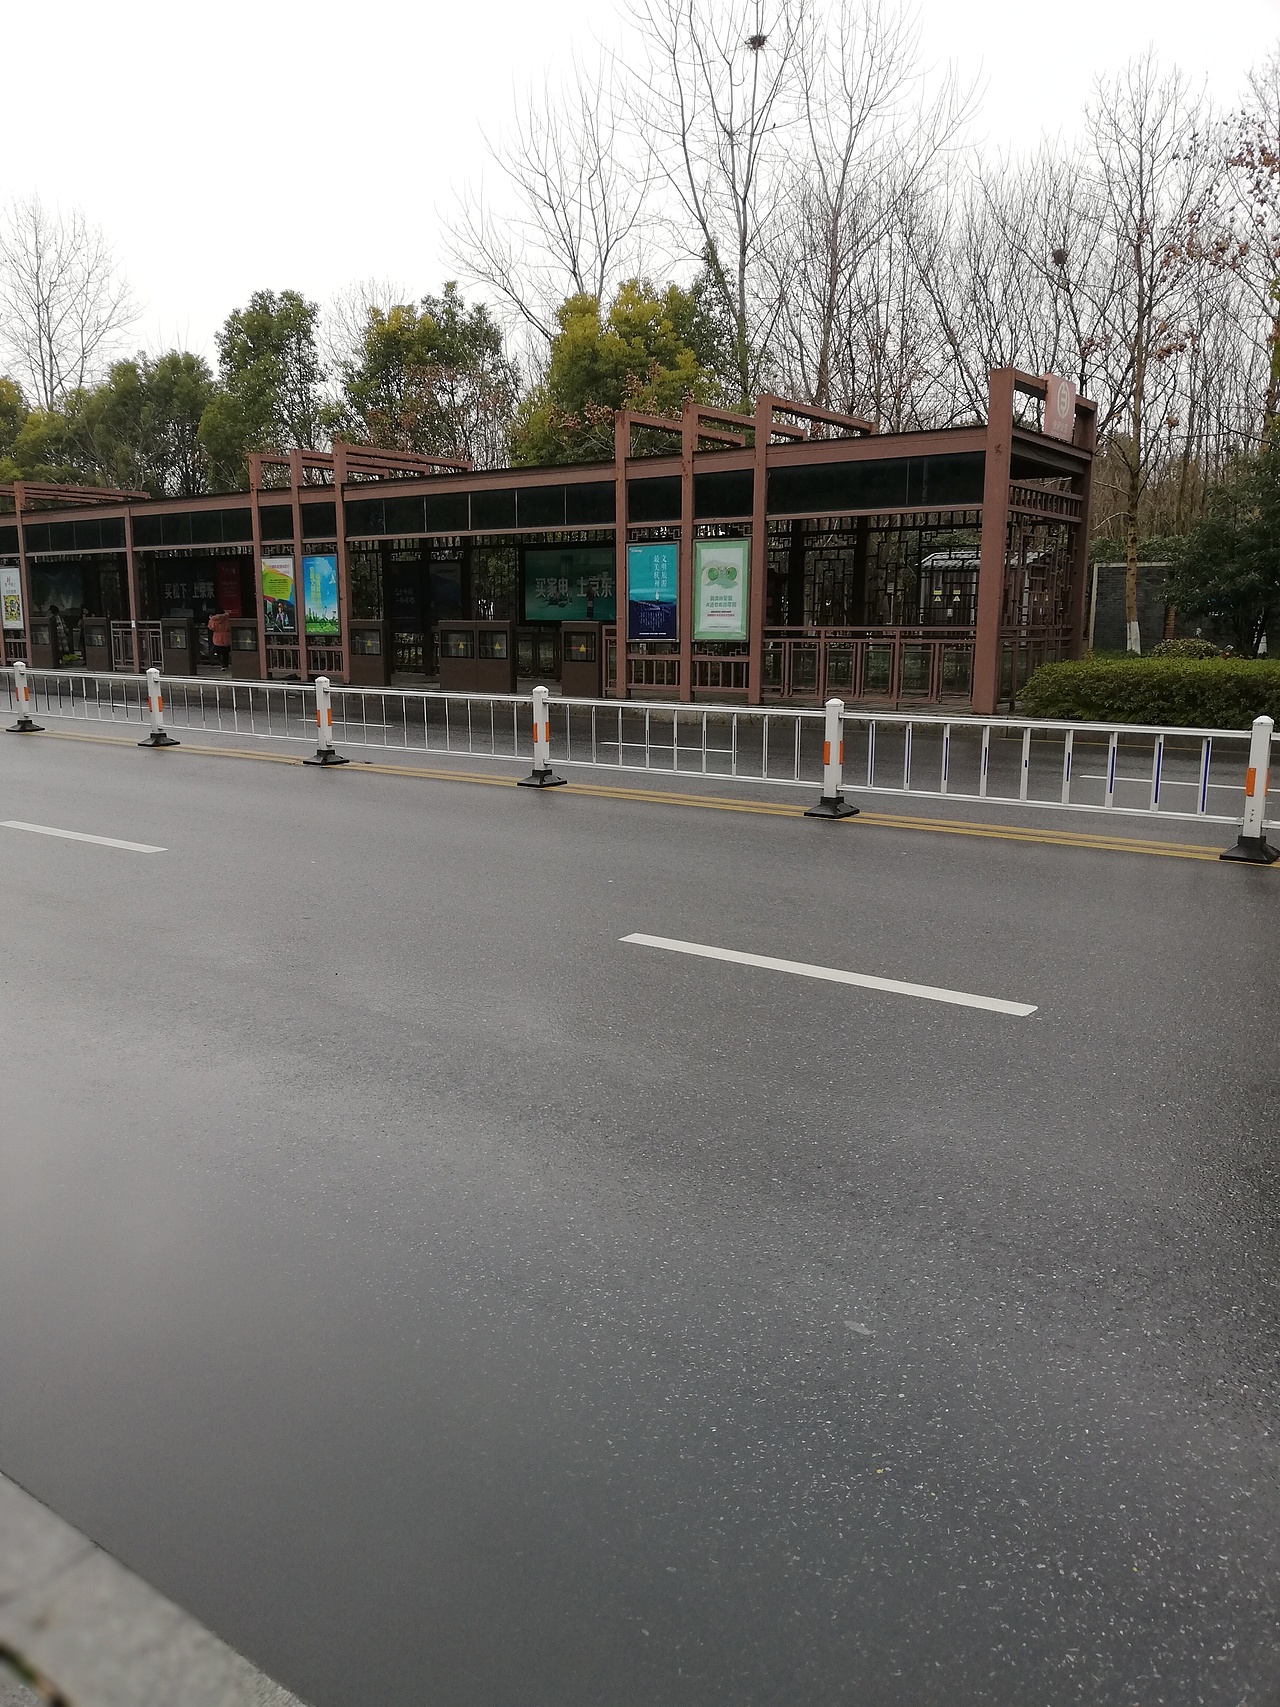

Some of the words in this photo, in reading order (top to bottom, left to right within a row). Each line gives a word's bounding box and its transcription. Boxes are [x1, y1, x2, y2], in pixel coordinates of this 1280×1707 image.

[535, 576, 569, 600] 买家电
[576, 575, 613, 598] 上京东
